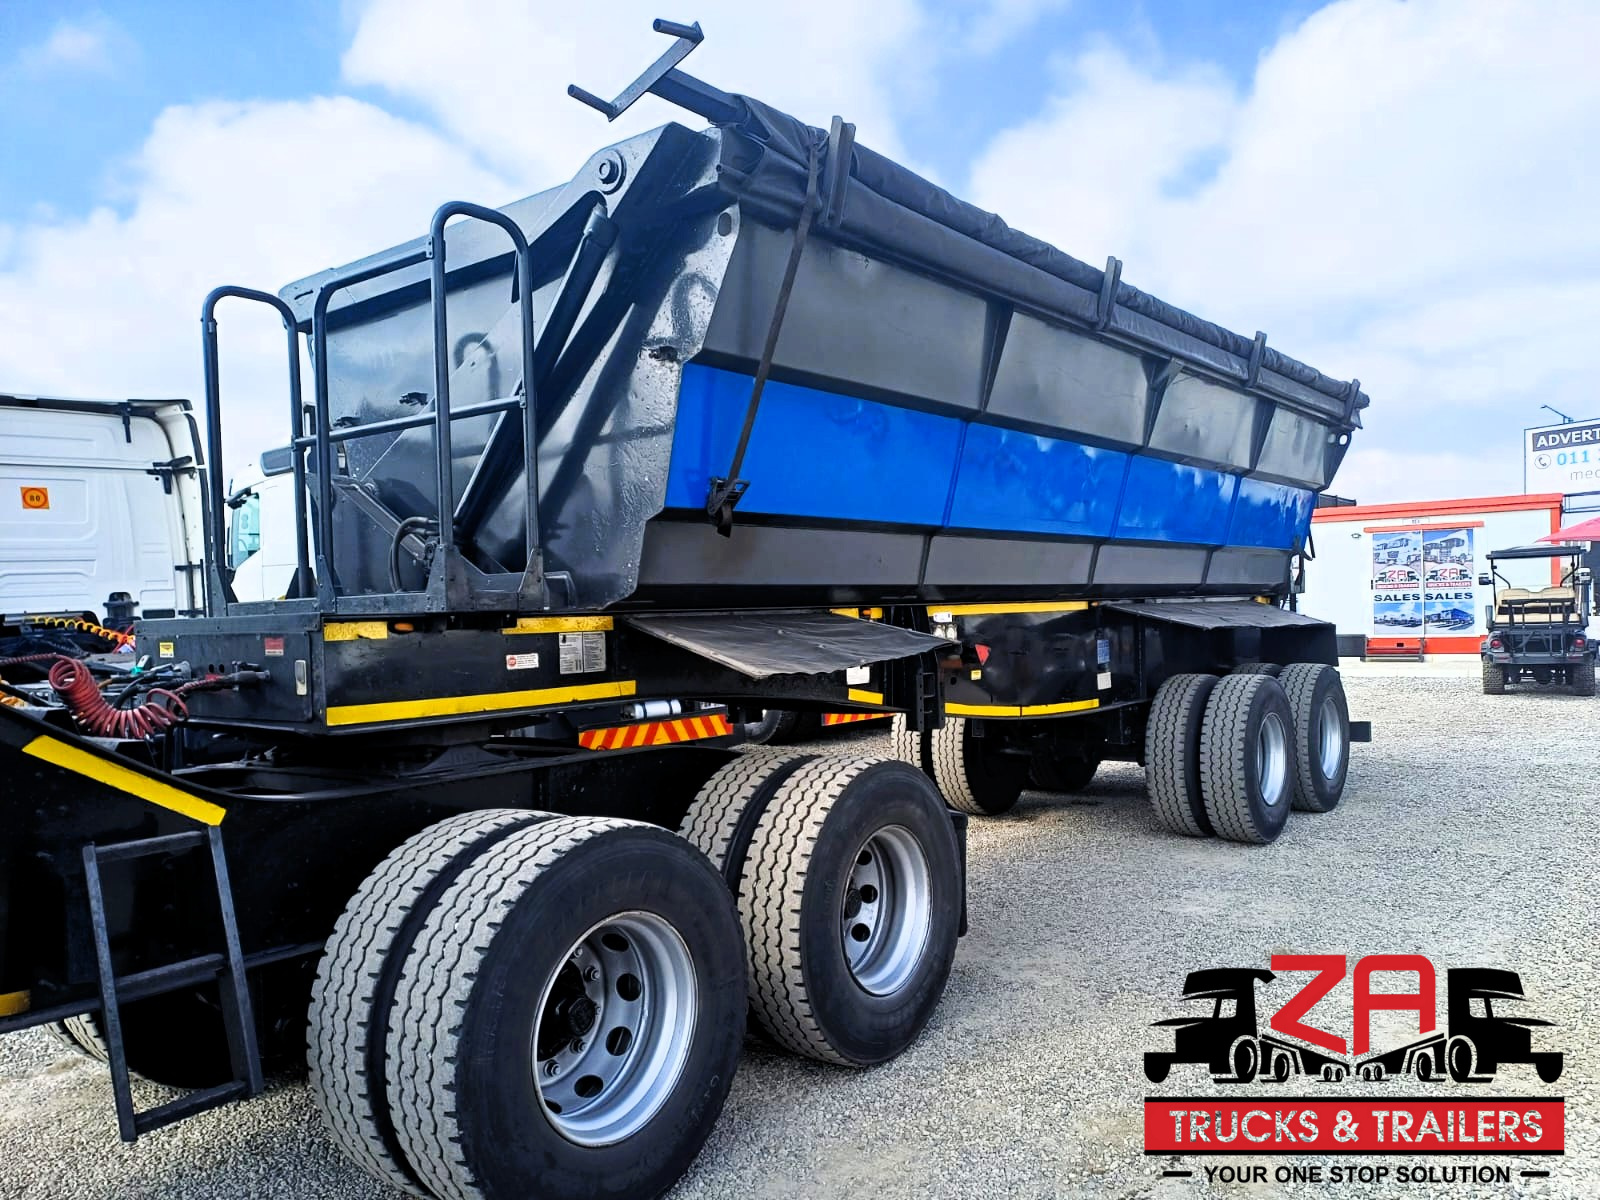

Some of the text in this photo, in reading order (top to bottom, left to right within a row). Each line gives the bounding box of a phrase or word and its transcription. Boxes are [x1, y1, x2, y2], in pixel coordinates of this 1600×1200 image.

[1537, 428, 1600, 448] ADVERT
[1557, 450, 1590, 466] 011
[1388, 570, 1406, 579] ZA
[1439, 568, 1458, 579] ZA
[1374, 594, 1420, 602] SALES
[1425, 592, 1473, 600] SALES
